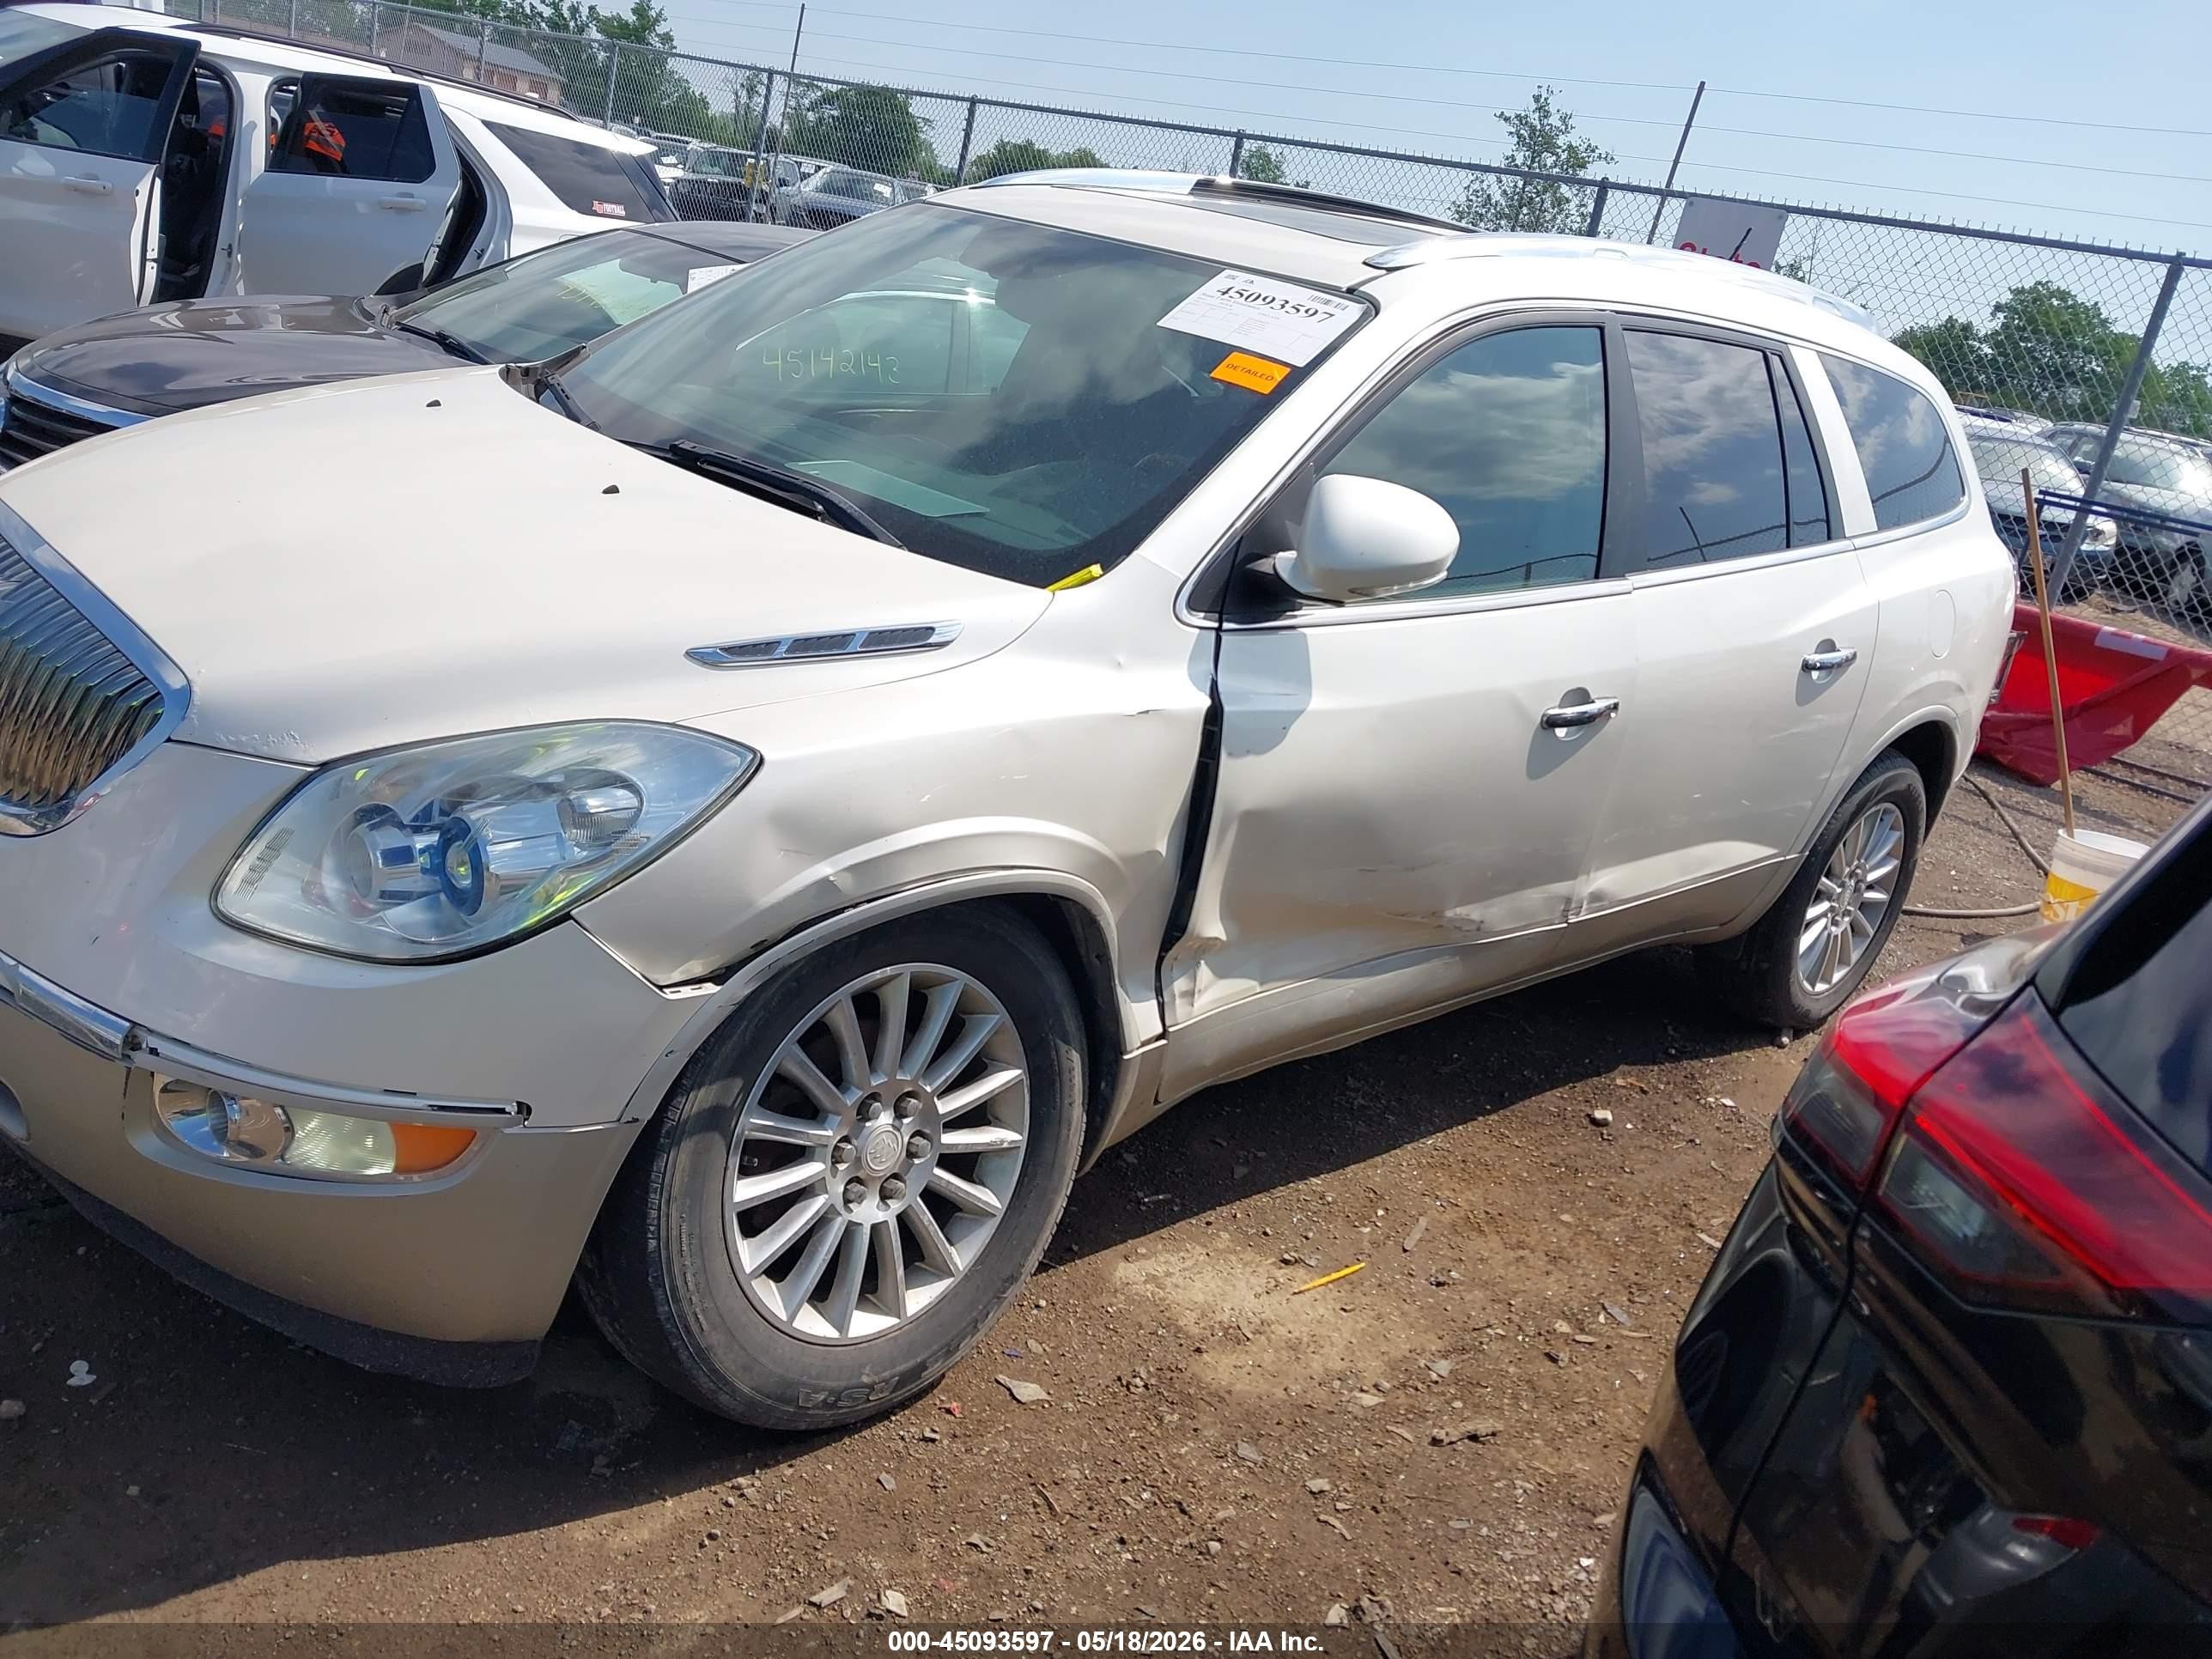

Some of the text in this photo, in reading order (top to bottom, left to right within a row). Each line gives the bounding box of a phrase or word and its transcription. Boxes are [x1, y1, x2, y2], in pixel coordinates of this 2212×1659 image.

[1216, 285, 1335, 323] 45093597
[763, 347, 901, 384] 45142143
[1225, 362, 1275, 381] DETAILED
